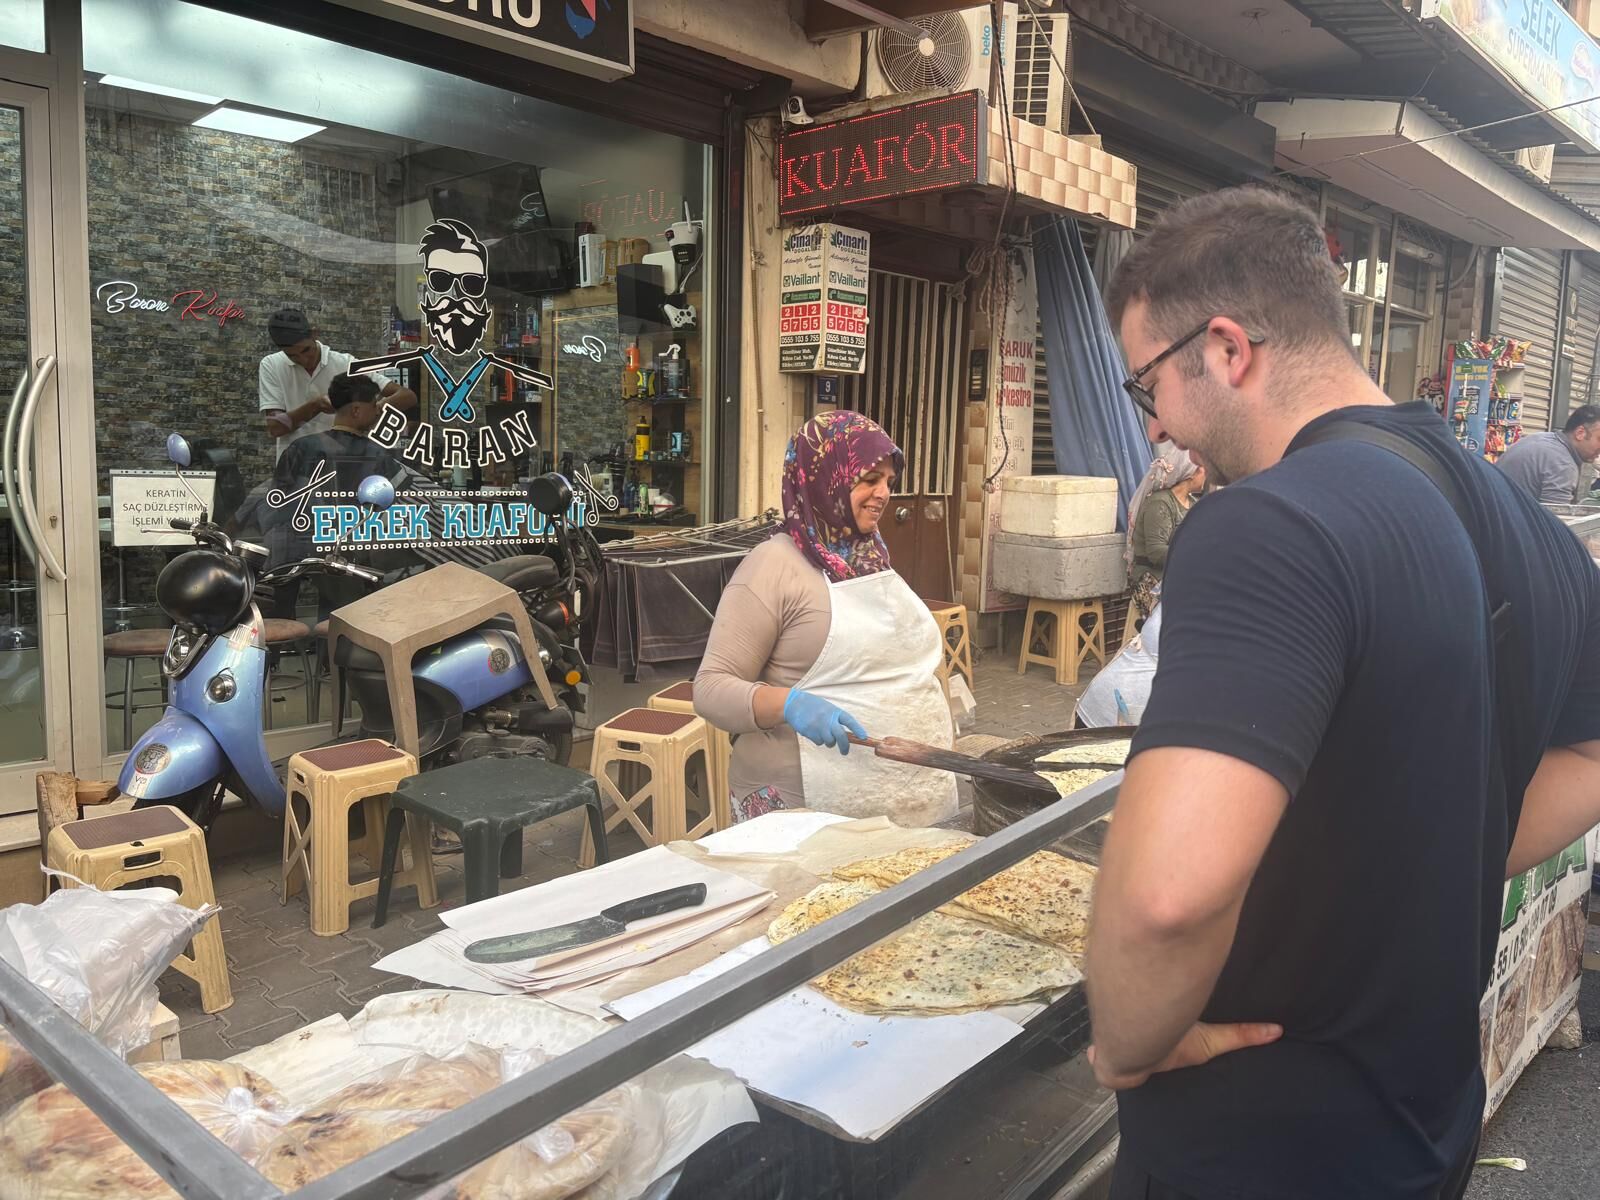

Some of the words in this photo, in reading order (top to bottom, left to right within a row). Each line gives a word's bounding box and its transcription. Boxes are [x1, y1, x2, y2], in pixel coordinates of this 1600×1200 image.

[1521, 0, 1561, 60] SELEK
[981, 24, 991, 56] beko
[783, 121, 971, 198] KUAFÖR
[790, 272, 821, 287] Vaillant
[836, 272, 867, 288] Vaillant
[825, 380, 831, 393] 9
[369, 403, 537, 468] BARAN
[146, 488, 186, 498] KERATİN
[122, 503, 142, 513] SAÇ
[144, 501, 207, 513] DÜZLEŞTİRM
[132, 515, 164, 527] İŞLEMİ
[312, 504, 432, 543] ERKEK
